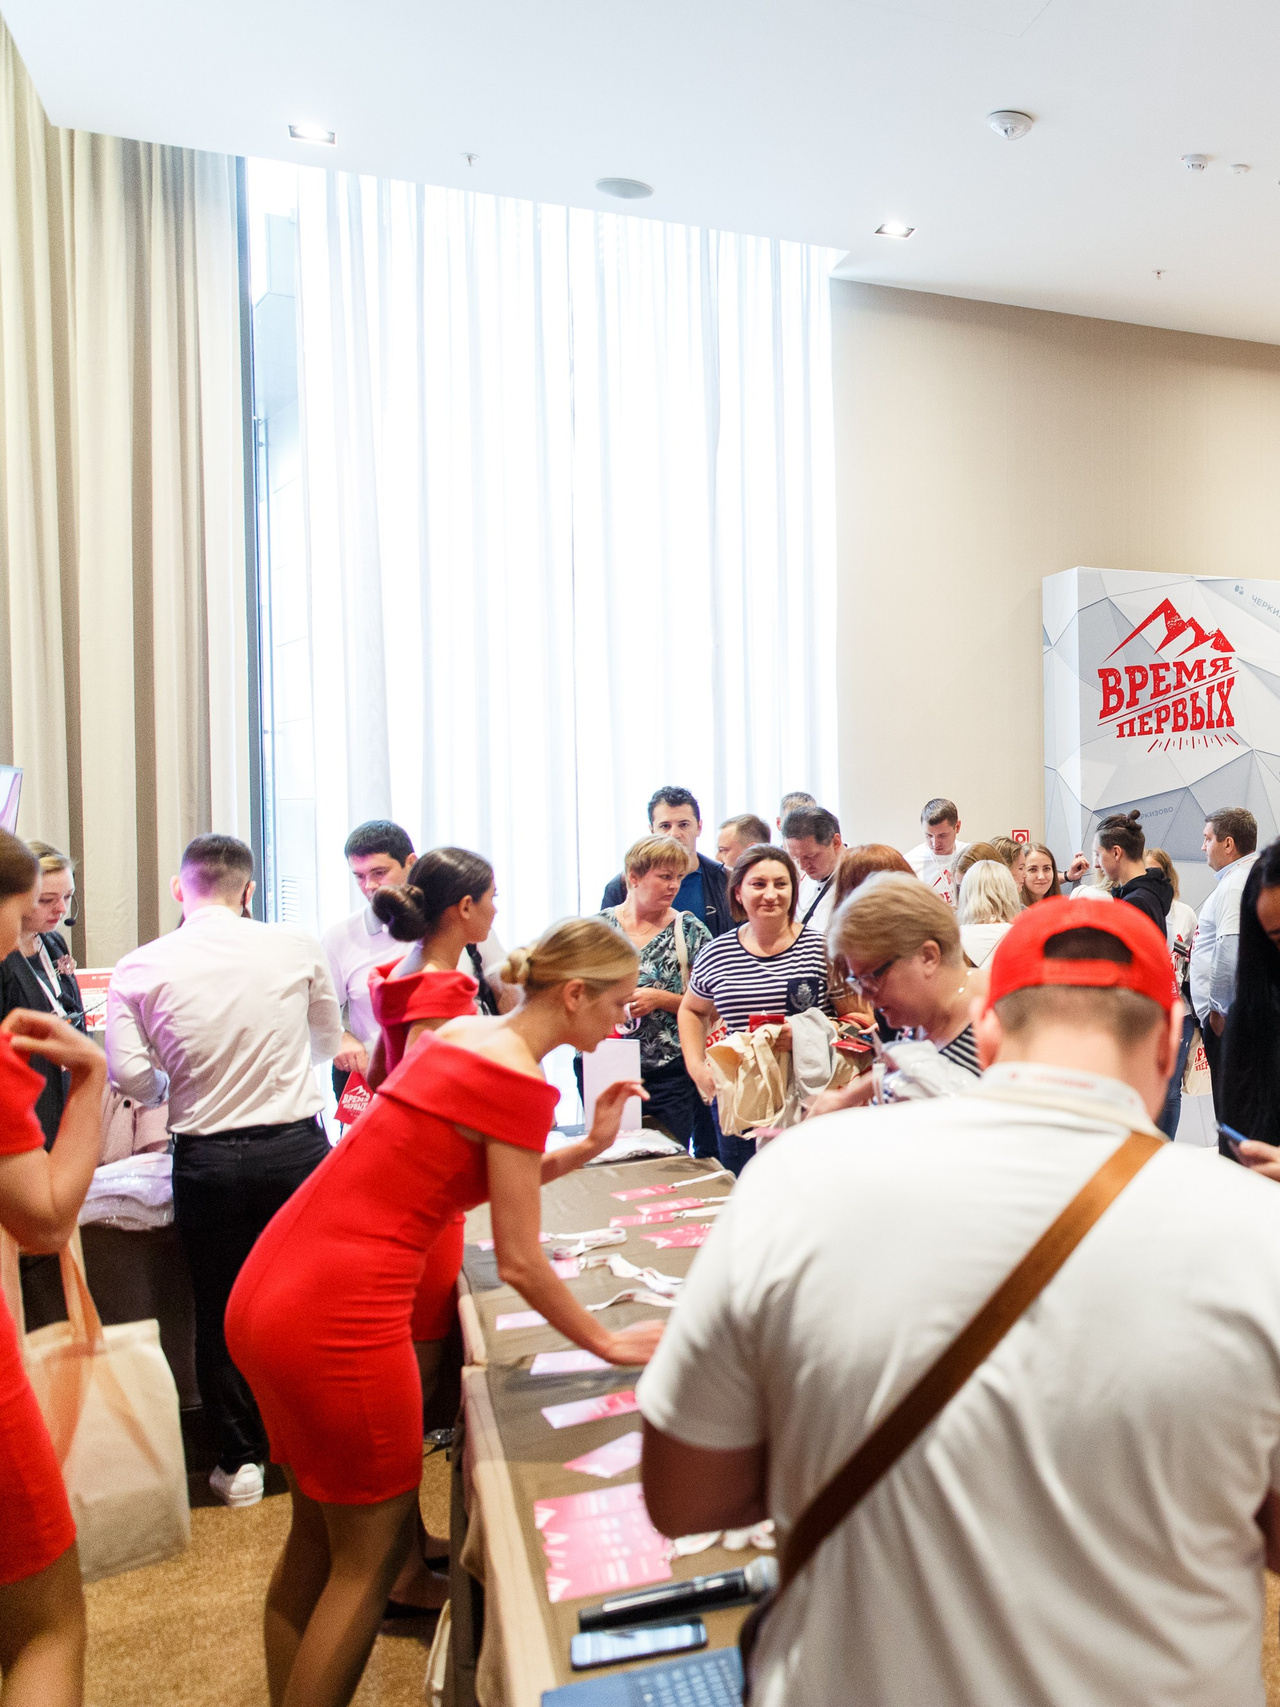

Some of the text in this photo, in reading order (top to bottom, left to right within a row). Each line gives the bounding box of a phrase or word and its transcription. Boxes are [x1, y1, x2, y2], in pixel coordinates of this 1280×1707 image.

[1097, 656, 1233, 720] ВРЕМЯ
[1116, 676, 1236, 739] ПЕРВЫХ
[1140, 806, 1174, 820] РКИЗОВО
